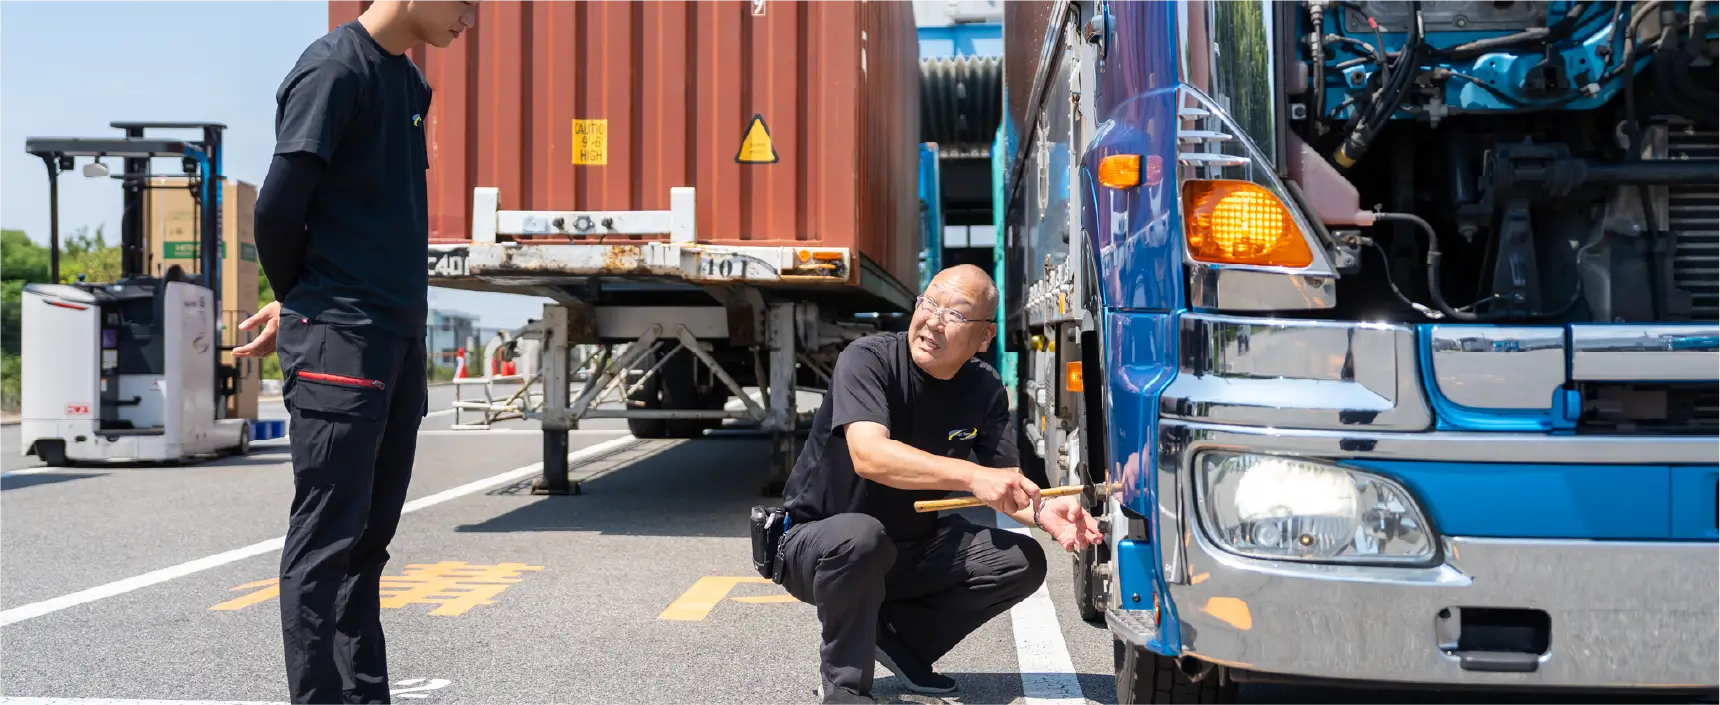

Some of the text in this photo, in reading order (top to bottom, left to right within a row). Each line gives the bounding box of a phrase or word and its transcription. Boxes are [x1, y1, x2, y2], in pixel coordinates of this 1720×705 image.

[575, 122, 605, 135] CAUTIO
[580, 149, 603, 161] HIGH
[702, 258, 748, 277] 401
